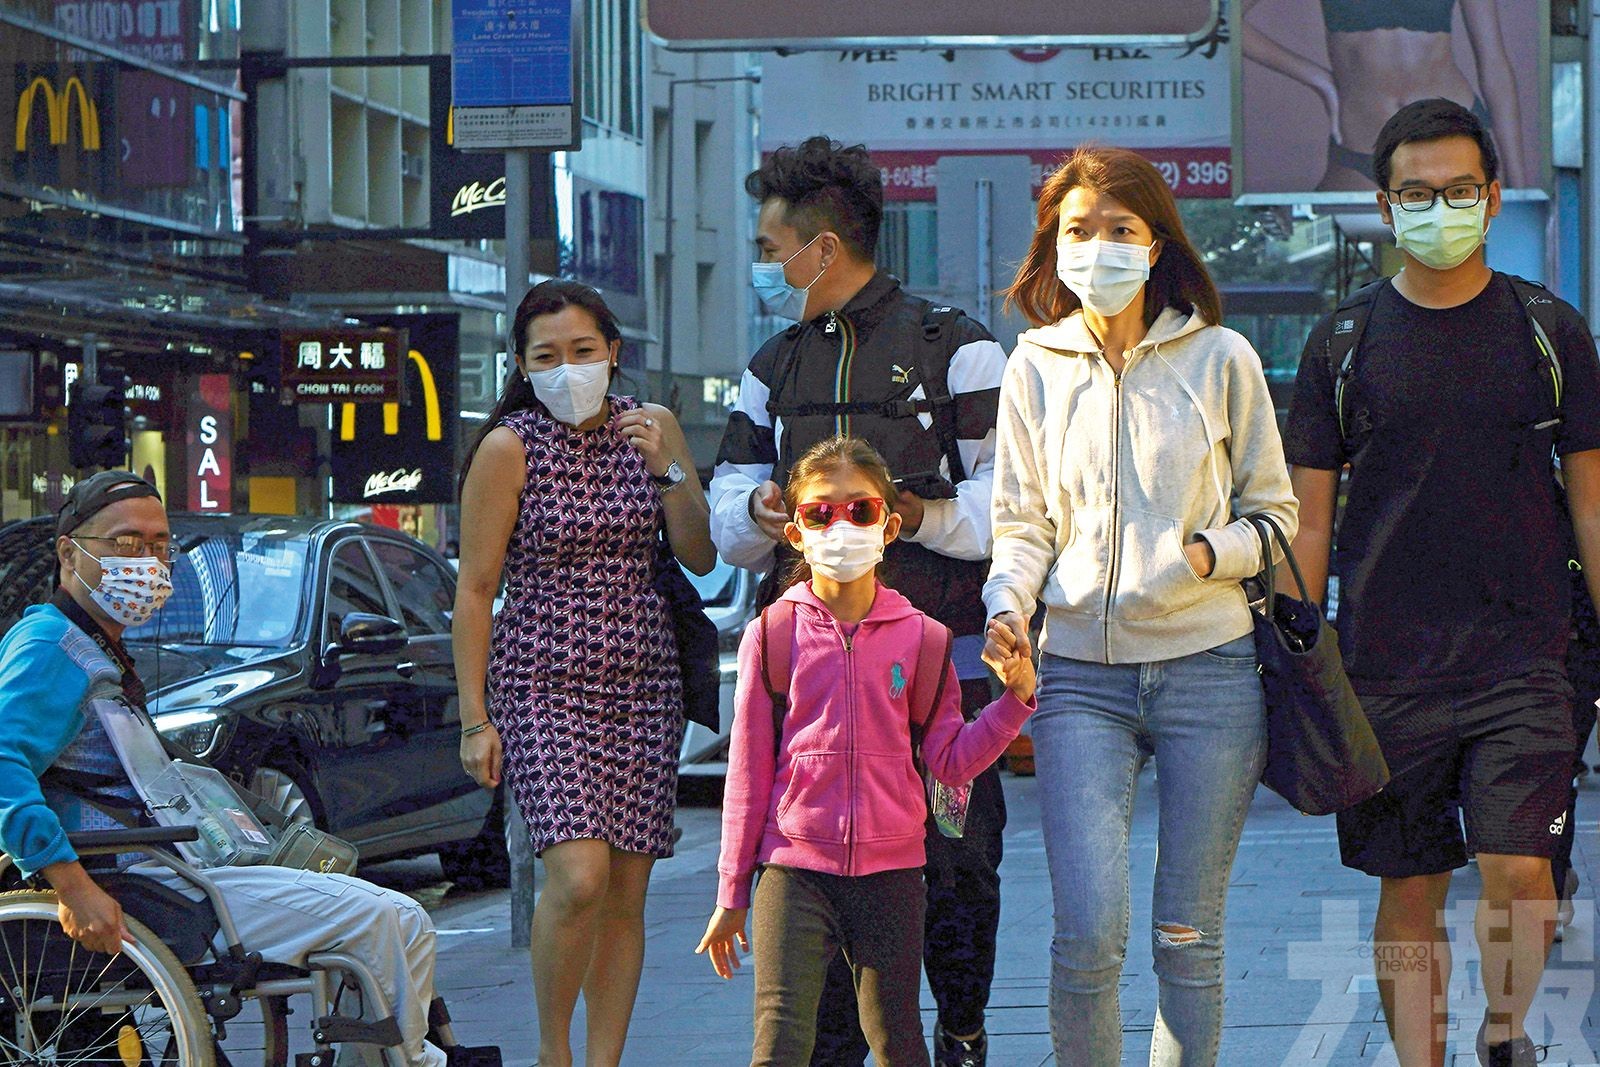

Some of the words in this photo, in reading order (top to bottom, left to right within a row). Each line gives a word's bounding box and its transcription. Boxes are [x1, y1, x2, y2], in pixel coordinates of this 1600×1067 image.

[867, 83, 961, 102] BRIGHT
[972, 82, 1056, 101] SMART
[1066, 80, 1205, 99] SECURITIES
[297, 341, 386, 370] 周大福
[296, 383, 330, 395] CHOW
[331, 383, 350, 394] TAI
[353, 383, 385, 394] FOOK
[197, 415, 221, 509] SAL
